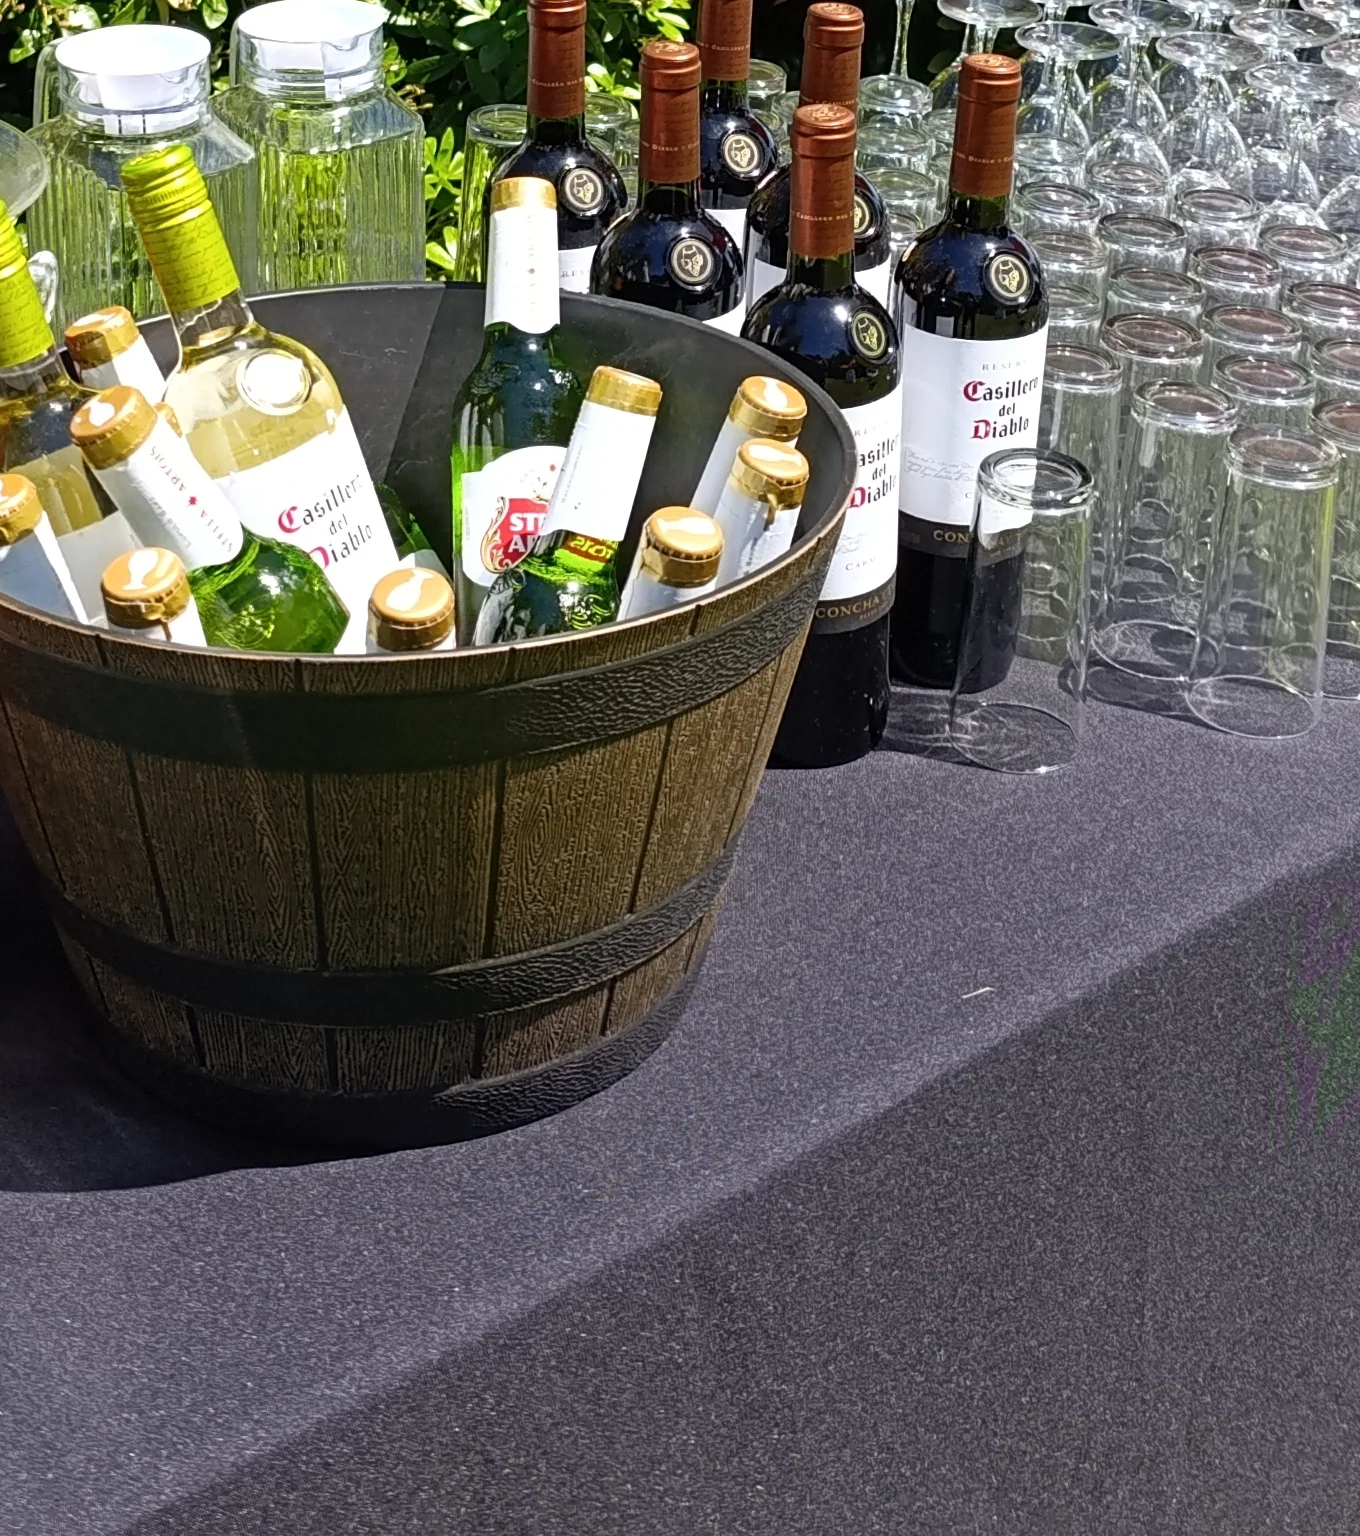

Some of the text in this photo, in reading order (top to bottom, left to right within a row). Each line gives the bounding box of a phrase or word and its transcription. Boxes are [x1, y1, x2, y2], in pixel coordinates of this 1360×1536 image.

[963, 376, 1038, 402] Casillero
[999, 403, 1016, 417] del
[971, 416, 1029, 440] Diablo
[872, 464, 887, 481] del
[329, 513, 348, 535] del
[816, 595, 880, 619] CONCHA
